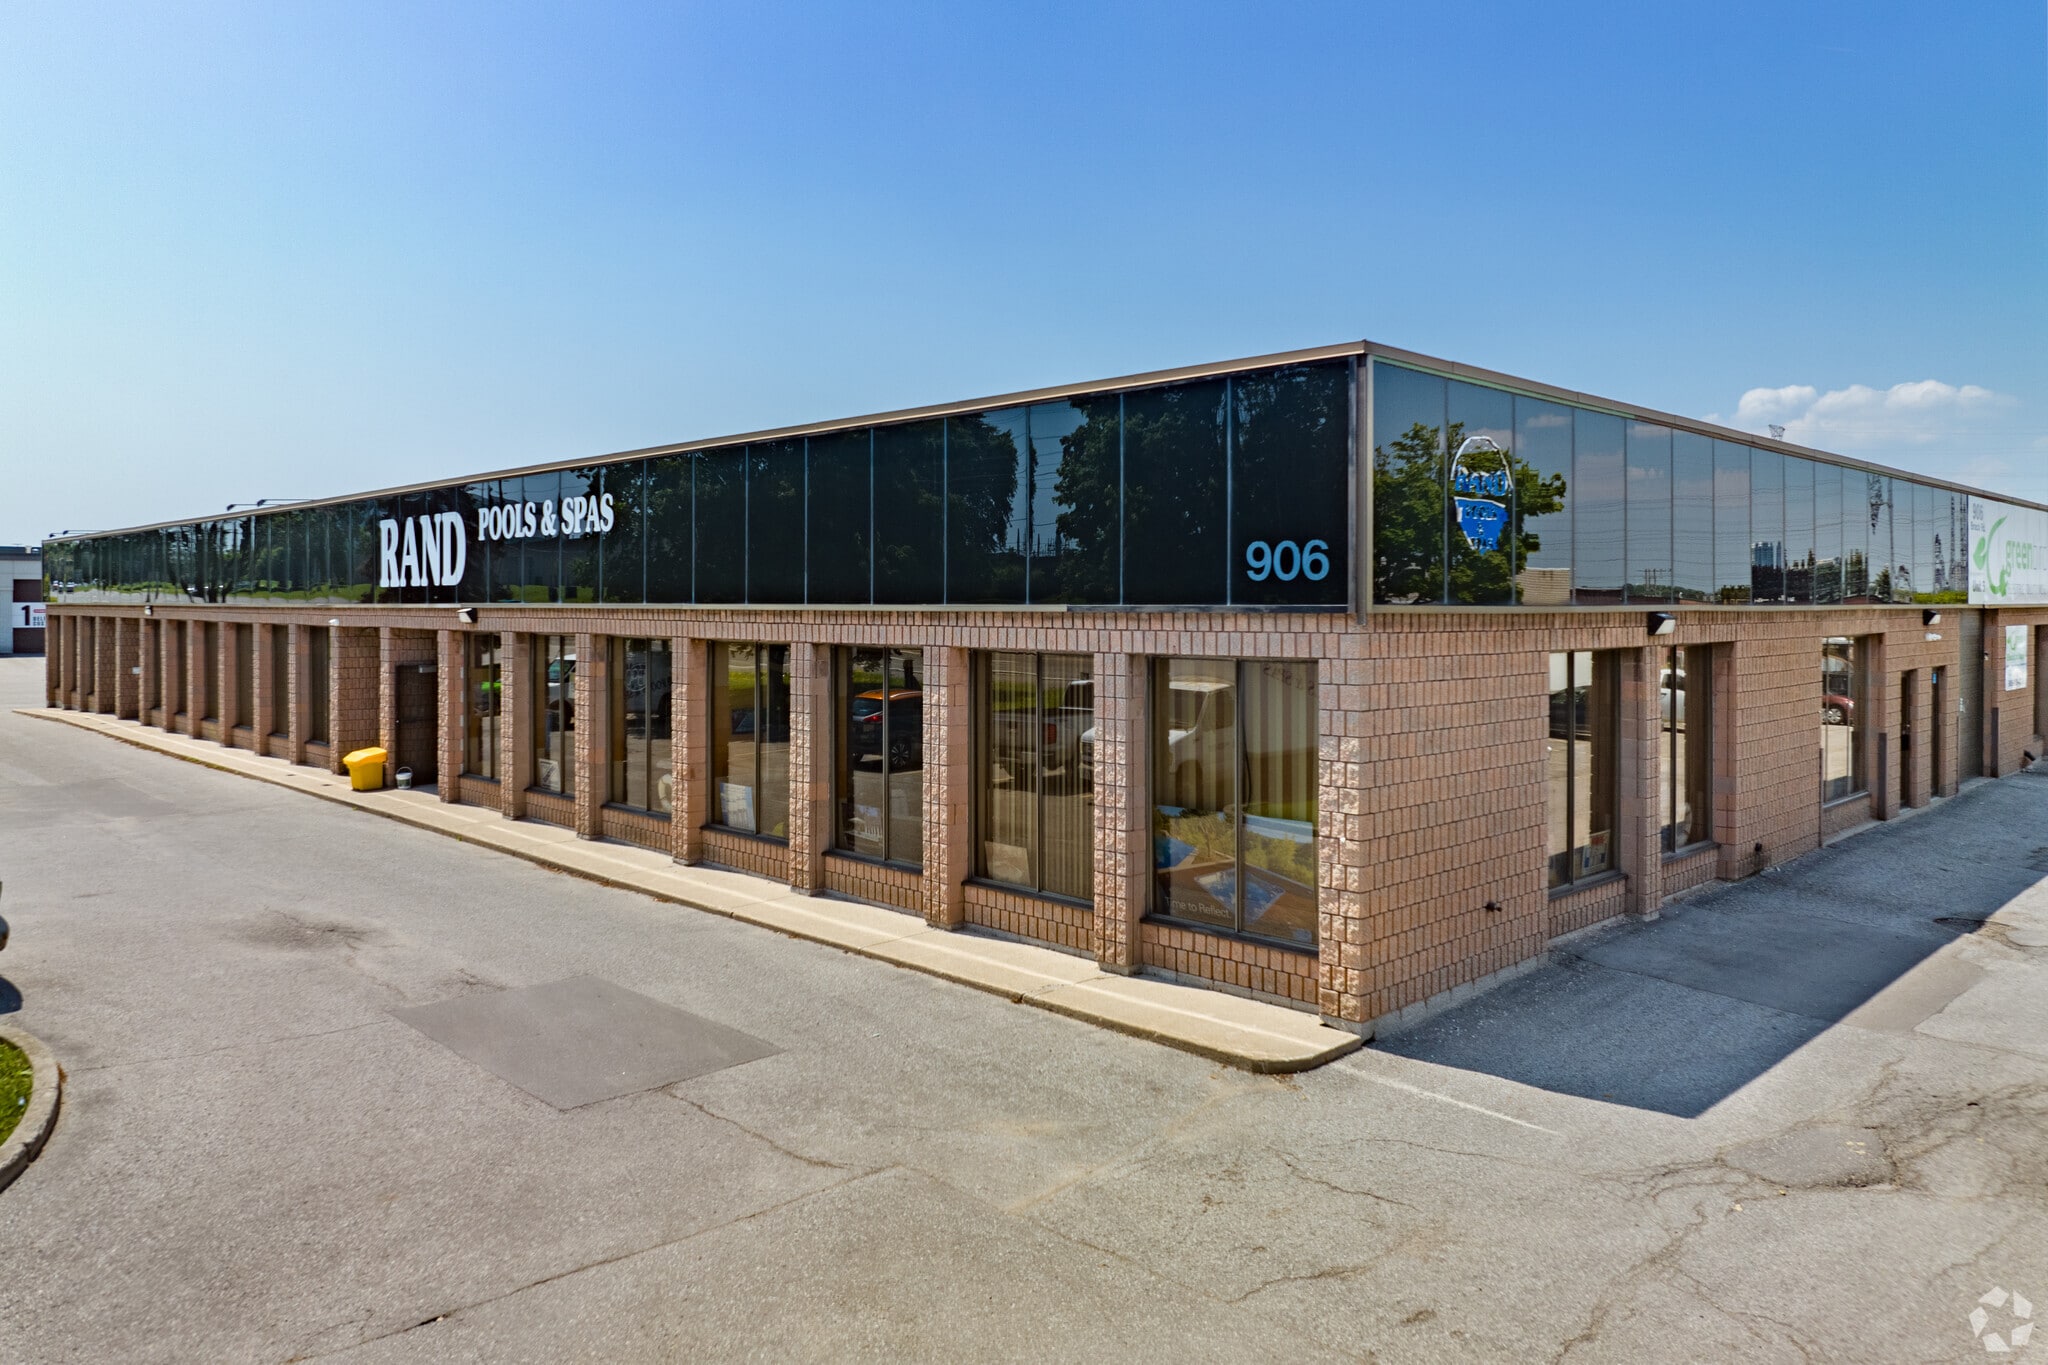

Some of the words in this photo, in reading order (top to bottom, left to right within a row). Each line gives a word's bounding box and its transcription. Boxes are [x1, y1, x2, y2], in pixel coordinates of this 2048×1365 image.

[379, 511, 466, 588] RAND
[478, 501, 536, 541] POOLS
[541, 499, 557, 536] &
[561, 493, 614, 535] SPAS
[1246, 539, 1330, 582] 906
[21, 605, 30, 626] 1
[1165, 897, 1186, 911] Tme
[1188, 904, 1198, 913] to
